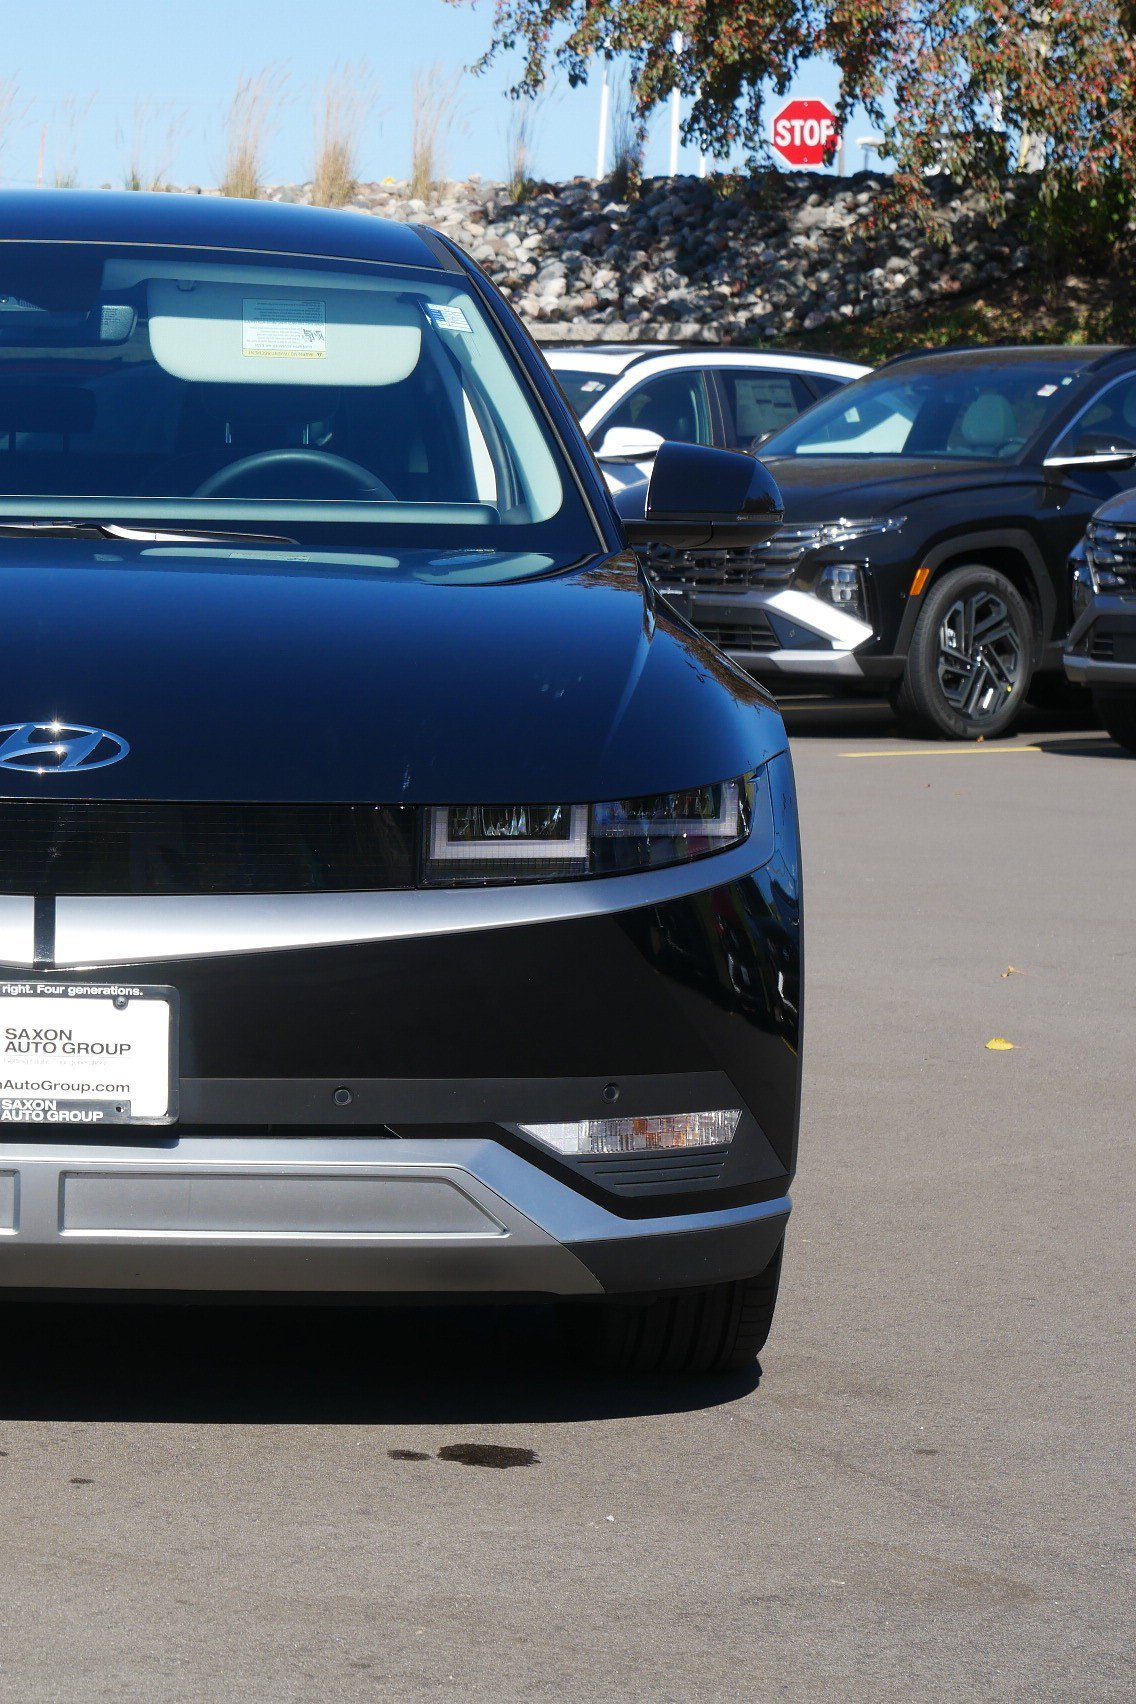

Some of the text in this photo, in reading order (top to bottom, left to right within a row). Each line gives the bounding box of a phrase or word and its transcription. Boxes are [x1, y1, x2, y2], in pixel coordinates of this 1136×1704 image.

[775, 119, 835, 146] STOP
[2, 984, 33, 995] right.
[37, 985, 65, 994] Four
[67, 987, 143, 996] generations.
[5, 1028, 73, 1041] SAXON
[4, 1041, 131, 1055] AUTO GROUP
[1, 1100, 57, 1110] SAXON
[1, 1110, 44, 1121] AUTO
[47, 1111, 104, 1122] GROUP
